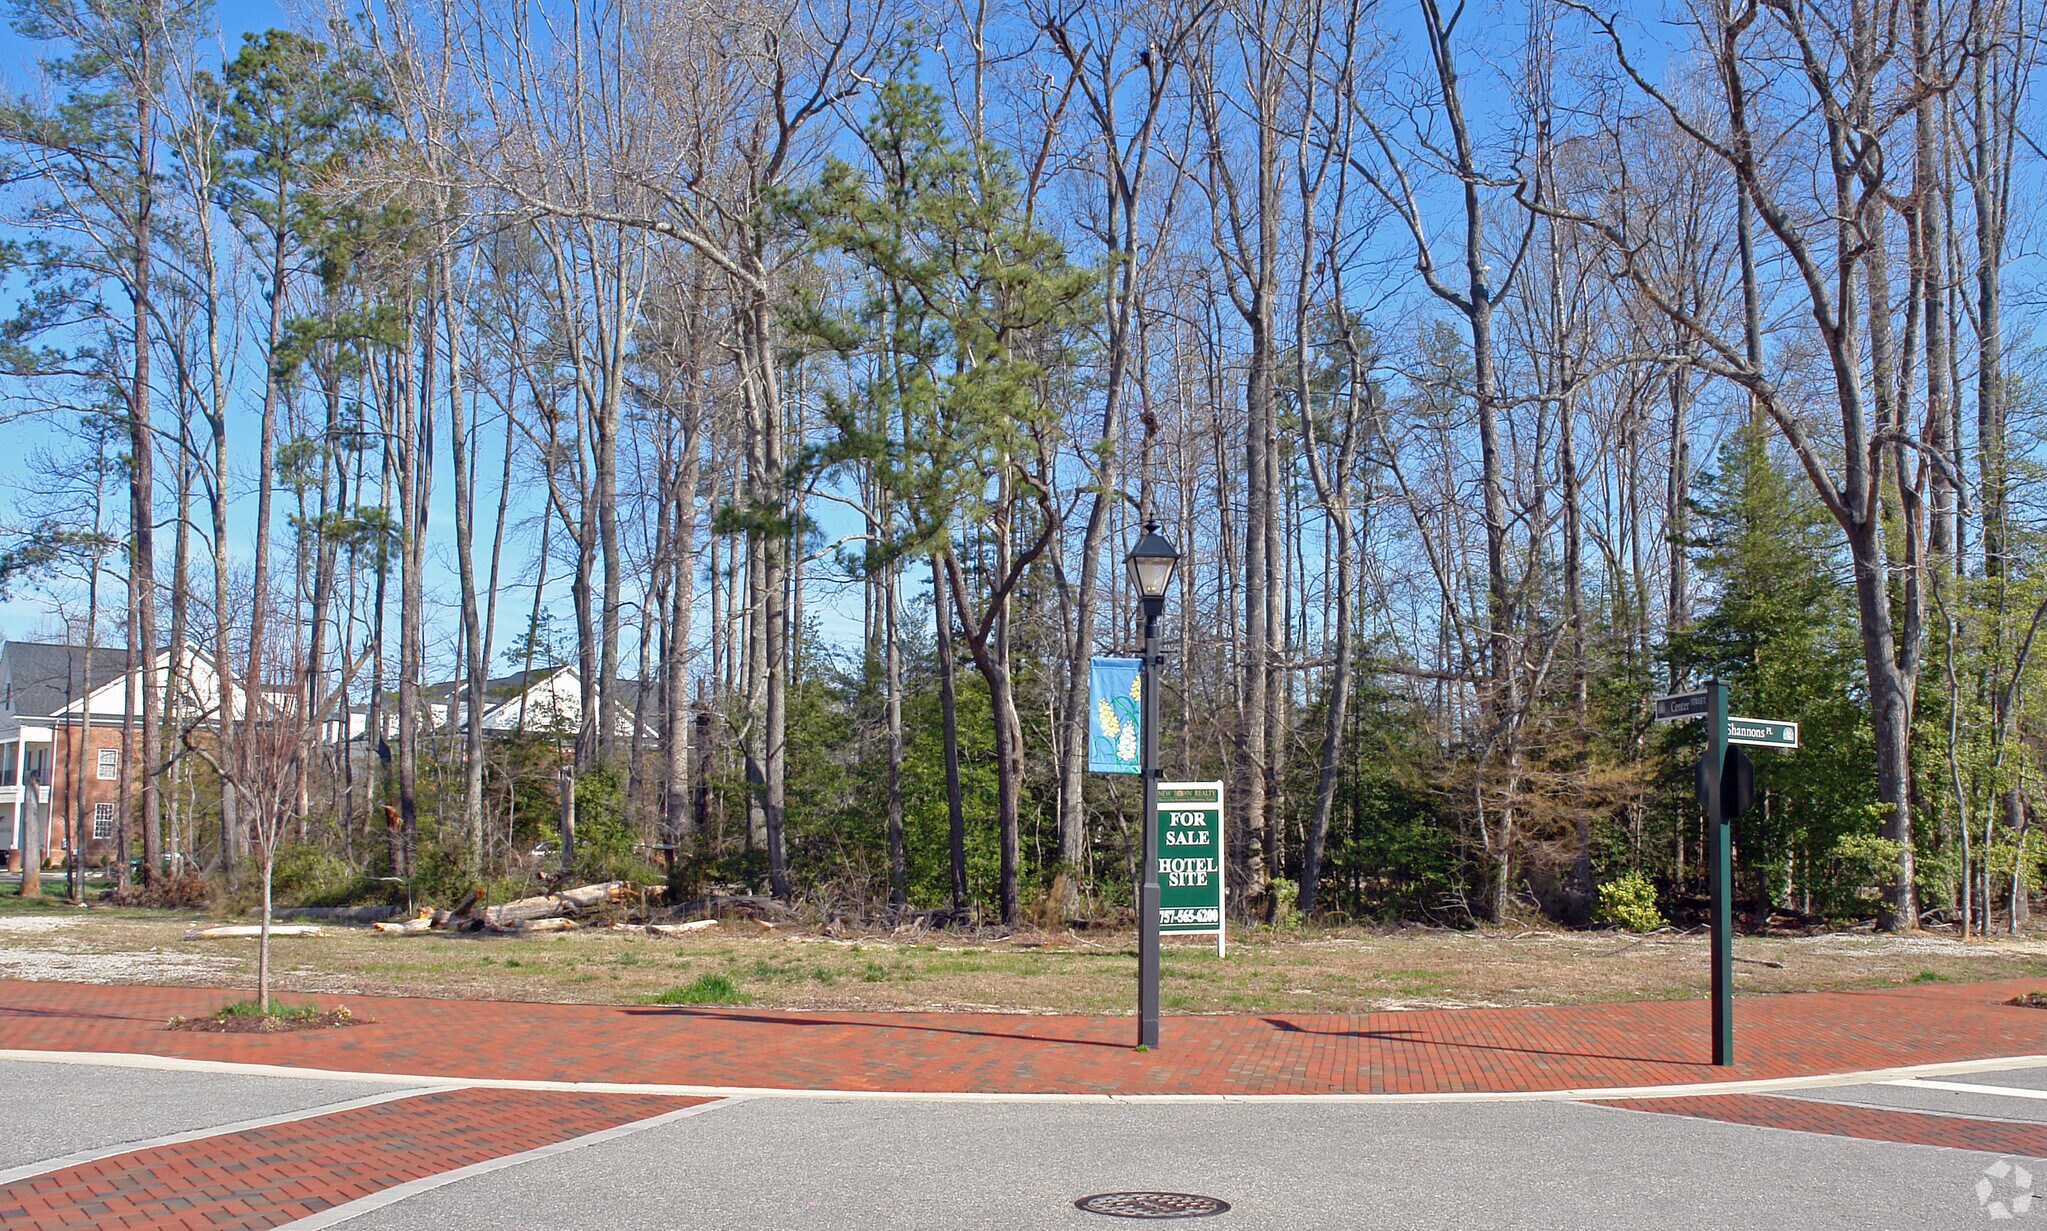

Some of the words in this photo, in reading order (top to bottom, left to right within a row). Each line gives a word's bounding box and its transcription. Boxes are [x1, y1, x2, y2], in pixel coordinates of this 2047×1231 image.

[1671, 702, 1690, 712] Center
[1728, 723, 1766, 738] Shannons
[1170, 812, 1206, 826] FOR
[1166, 831, 1210, 845] SALE
[1158, 858, 1218, 873] HOTEL
[1169, 872, 1208, 886] SITE
[1159, 909, 1218, 924] 757-565-6200
